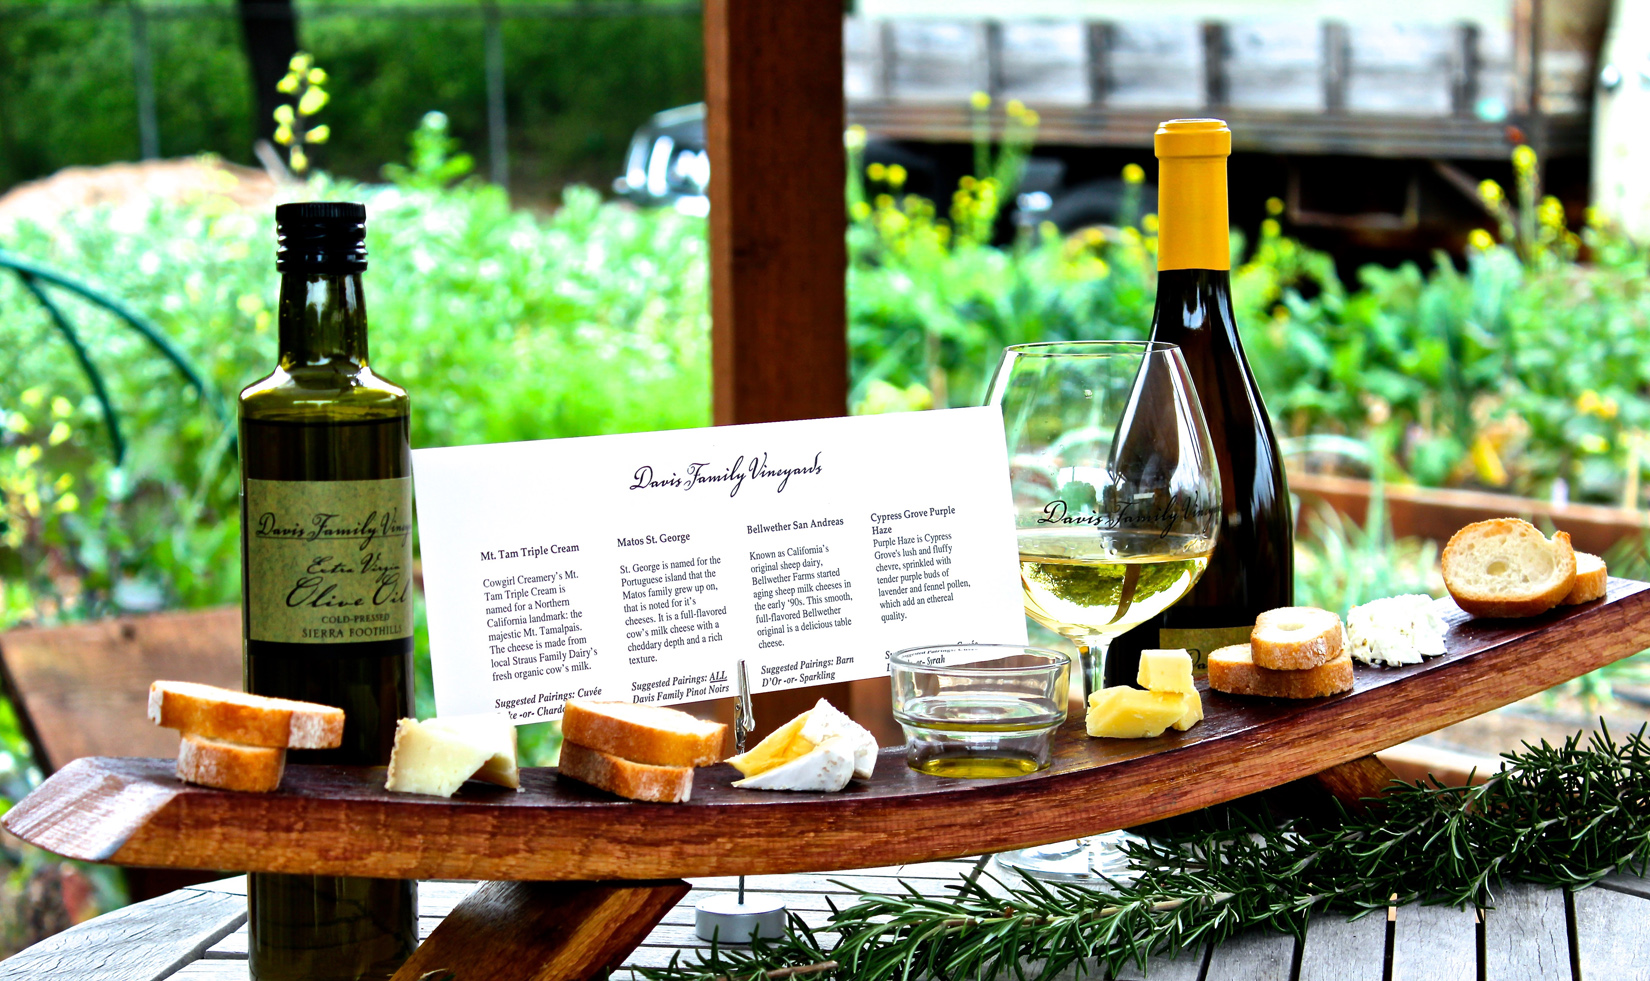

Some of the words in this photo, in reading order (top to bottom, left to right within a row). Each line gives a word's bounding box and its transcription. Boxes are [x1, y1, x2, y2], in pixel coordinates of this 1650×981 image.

[629, 465, 682, 490] Davis
[683, 455, 746, 498] Family
[748, 451, 822, 493] Vineyards
[870, 513, 902, 524] Cypress
[904, 510, 928, 518] Grove
[929, 506, 955, 517] Purple
[1037, 500, 1102, 526] Davis
[1104, 495, 1178, 539] Family
[255, 512, 304, 537] Davis
[307, 510, 378, 551] Family
[747, 522, 791, 534] Bellwether
[793, 521, 808, 530] San
[810, 518, 844, 528] Andreas
[872, 526, 892, 535] Haze
[617, 538, 644, 547] Matos
[646, 535, 657, 544] St.
[659, 534, 690, 544] George
[873, 538, 895, 548] Purple
[897, 536, 915, 545] Haze
[917, 535, 923, 543] is
[924, 534, 952, 544] Cypress
[481, 551, 496, 561] Mt.
[498, 550, 519, 559] Tam
[520, 546, 548, 558] Triple
[550, 544, 579, 554] Cream
[750, 552, 776, 560] Known
[787, 544, 829, 556] California's
[874, 549, 901, 559] Grove's
[902, 548, 917, 557] lush
[919, 546, 931, 555] and
[933, 544, 952, 554] fluffy
[306, 556, 354, 574] Extra
[360, 552, 400, 583] Virgin
[620, 565, 630, 574] St.
[632, 564, 660, 573] George
[662, 561, 668, 569] is
[670, 558, 695, 569] named
[697, 557, 707, 566] for
[709, 556, 721, 564] the
[751, 562, 778, 574] original
[780, 561, 801, 571] sheep
[802, 558, 823, 568] dairy,
[876, 563, 901, 572] chevre,
[902, 558, 934, 571] sprinkled
[936, 556, 951, 565] with
[483, 576, 515, 588] Cowgirl
[517, 572, 563, 584] Creamery's
[565, 570, 578, 579] Mt.
[621, 577, 663, 587] Portuguese
[665, 572, 687, 582] island
[689, 571, 702, 579] that
[704, 569, 716, 578] the
[752, 574, 791, 585] Bellwether
[793, 572, 815, 581] Farms
[817, 568, 840, 578] started
[877, 575, 898, 584] tender
[900, 572, 922, 584] purple
[923, 570, 940, 579] buds
[942, 568, 949, 577] of
[286, 576, 365, 608] Olive
[372, 573, 410, 606] Oil
[484, 592, 503, 601] Tam
[504, 588, 529, 600] Triple
[531, 587, 557, 596] Cream
[559, 584, 566, 593] is
[623, 591, 646, 600] Matos
[648, 587, 672, 597] family
[675, 586, 692, 596] grew
[695, 585, 704, 594] up
[753, 589, 773, 600] aging
[775, 587, 795, 596] sheep
[797, 584, 814, 593] milk
[815, 582, 842, 591] cheeses
[844, 580, 851, 588] in
[878, 586, 908, 597] lavender
[910, 584, 922, 593] and
[924, 581, 945, 591] fennel
[947, 579, 970, 591] pollen,
[486, 603, 512, 614] named
[514, 602, 525, 611] for
[535, 599, 570, 609] Northern
[624, 604, 638, 613] that
[640, 602, 647, 611] is
[649, 599, 670, 610] noted
[671, 599, 682, 607] for
[880, 599, 901, 608] which
[903, 597, 915, 606] add
[927, 592, 954, 603] ethereal
[321, 613, 390, 624] COLD-PRESSED
[487, 616, 527, 627] California
[529, 611, 568, 623] landmark:
[570, 609, 582, 618] the
[625, 617, 656, 626] cheeses.
[658, 613, 664, 622] It
[666, 613, 672, 621] is
[681, 606, 727, 619] full-flavored
[756, 610, 801, 623] full-flavored
[802, 607, 841, 618] Bellwether
[881, 611, 907, 623] quality.
[302, 627, 344, 638] SIERRA
[350, 625, 402, 637] FOOTHILLS
[488, 630, 521, 642] majestic
[523, 628, 537, 637] Mt.
[539, 623, 582, 635] Tamalpais.
[757, 625, 785, 637] original
[787, 624, 793, 632] is
[801, 621, 833, 631] delicious
[834, 617, 851, 627] table
[489, 645, 505, 654] The
[507, 643, 533, 652] cheese
[536, 640, 542, 649] is
[545, 638, 565, 648] made
[568, 636, 587, 645] from
[628, 641, 662, 652] cheddary
[664, 637, 685, 649] depth
[687, 635, 700, 645] and
[708, 632, 723, 642] rich
[758, 640, 784, 649] cheese.
[491, 657, 510, 668] local
[513, 656, 537, 665] Straus
[539, 651, 566, 662] Family
[569, 647, 598, 659] Dairy's
[629, 656, 657, 664] texture.
[761, 661, 798, 675] Suggested
[800, 659, 834, 669] Pairings:
[836, 656, 854, 665] Barn
[492, 671, 512, 681] fresh
[514, 667, 543, 680] organic
[546, 664, 569, 675] cow's
[571, 661, 591, 671] milk.
[762, 677, 782, 687] D'Or
[800, 671, 835, 684] Sparkling
[631, 677, 670, 692] Suggested
[672, 675, 707, 686] Pairings:
[709, 671, 727, 683] ALL
[495, 694, 536, 709] Suggested
[538, 692, 575, 703] Pairings:
[577, 686, 602, 698] Cuvée
[633, 693, 655, 704] Davis
[657, 689, 684, 701] Family
[686, 687, 706, 697] Pinot
[708, 684, 729, 694] Noirs
